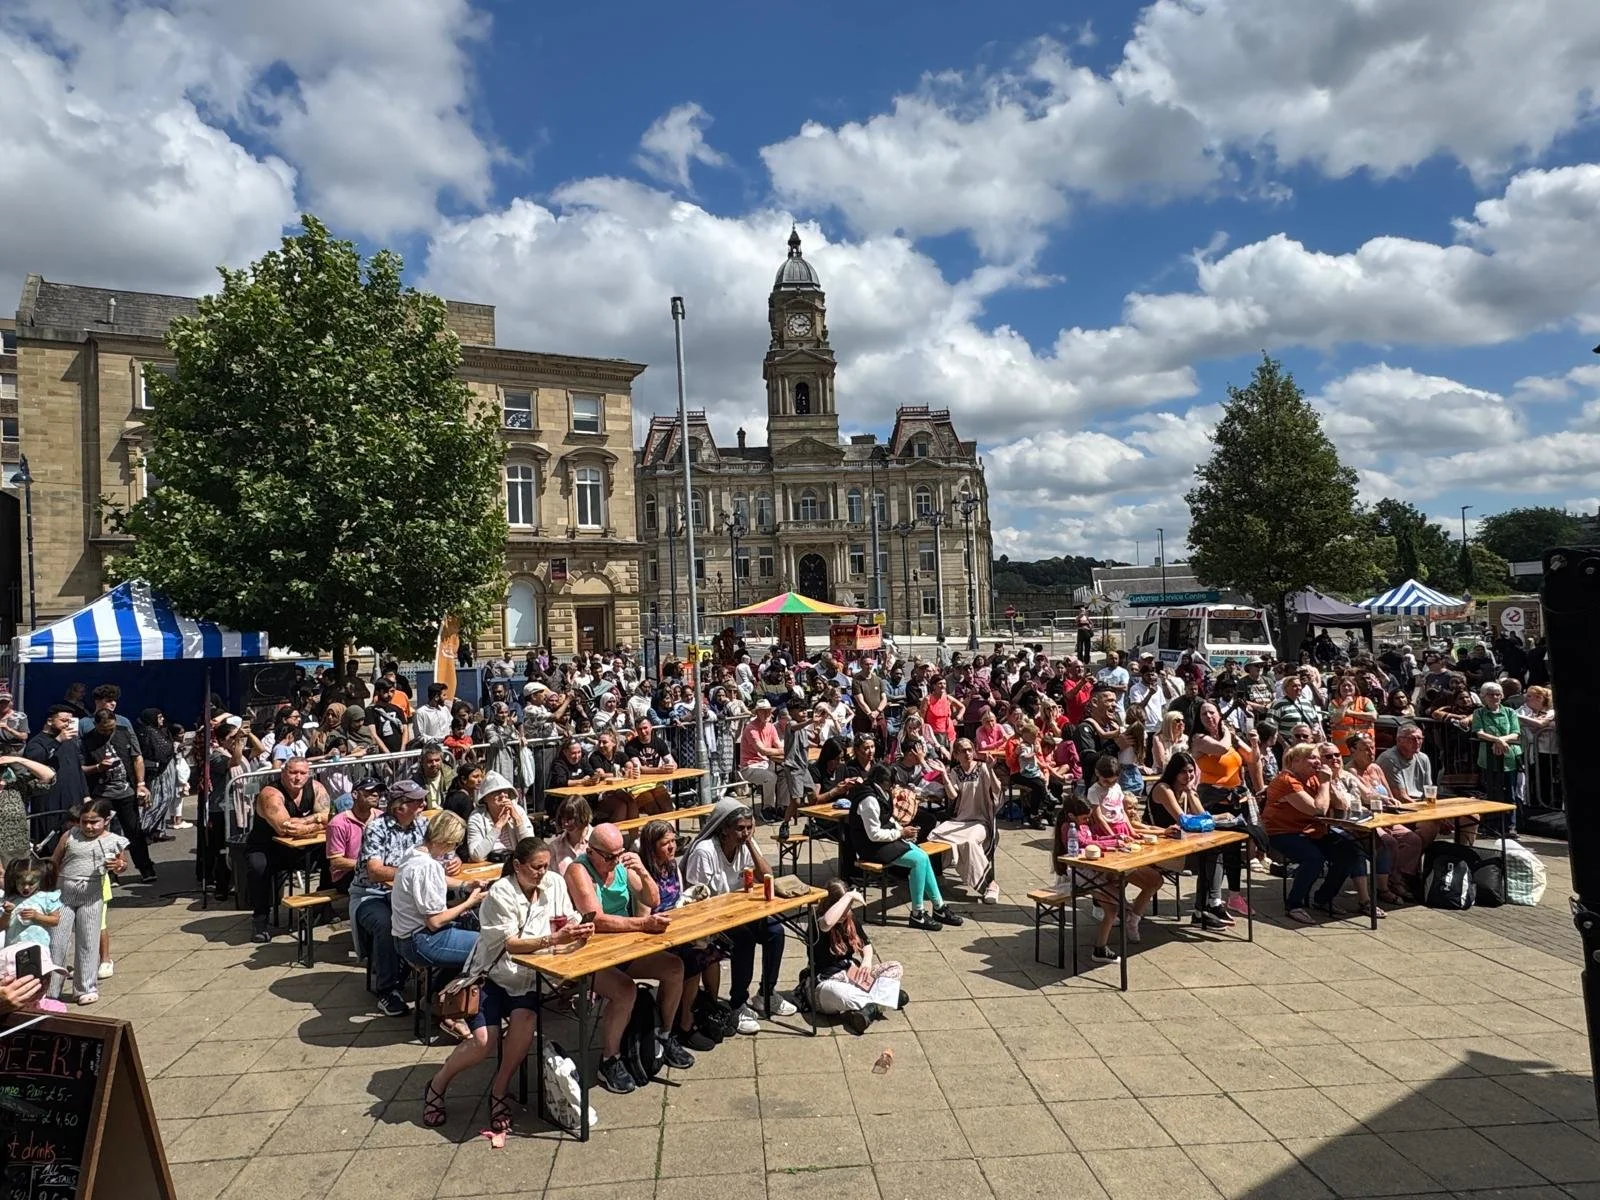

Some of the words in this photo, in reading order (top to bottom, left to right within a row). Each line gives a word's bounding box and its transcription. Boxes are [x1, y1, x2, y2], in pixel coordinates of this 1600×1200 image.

[1129, 595, 1159, 603] Customer
[1160, 593, 1184, 602] Service
[1184, 592, 1207, 600] Centre
[1443, 862, 1454, 891] HEAD
